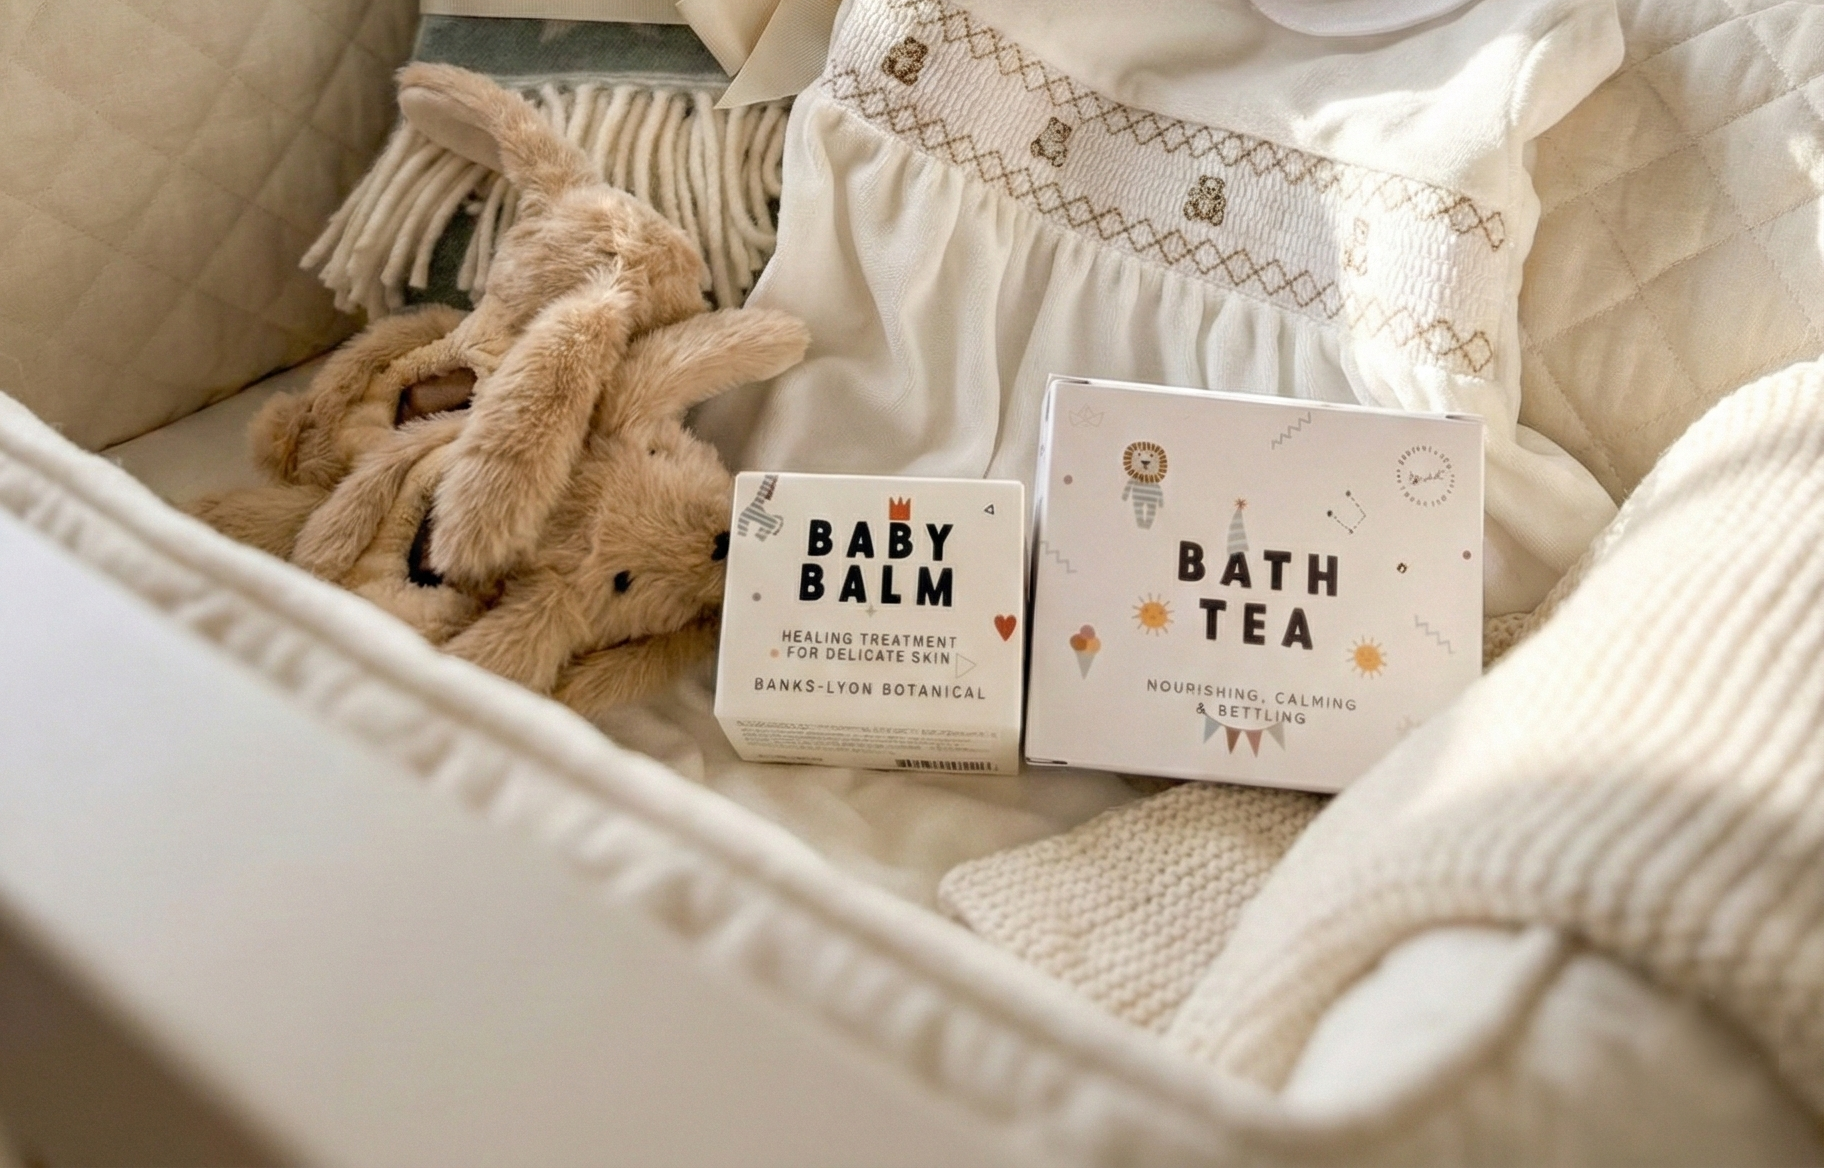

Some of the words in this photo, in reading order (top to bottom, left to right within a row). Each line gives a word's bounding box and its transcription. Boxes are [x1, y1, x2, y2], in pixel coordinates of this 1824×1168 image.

[808, 519, 953, 561] BABY
[1177, 540, 1339, 597] BATH
[799, 563, 952, 607] BALM
[1199, 598, 1313, 650] TEA
[782, 630, 852, 645] HEALING
[861, 633, 957, 648] TREATMENT
[787, 646, 818, 659] FOR
[826, 648, 904, 662] DELICATE
[912, 651, 950, 664] SKIN
[755, 678, 872, 695] BANKS-LYON
[882, 683, 986, 700] BOTANICAL
[1275, 692, 1357, 711] CALMING
[1218, 704, 1306, 725] BETTLING
